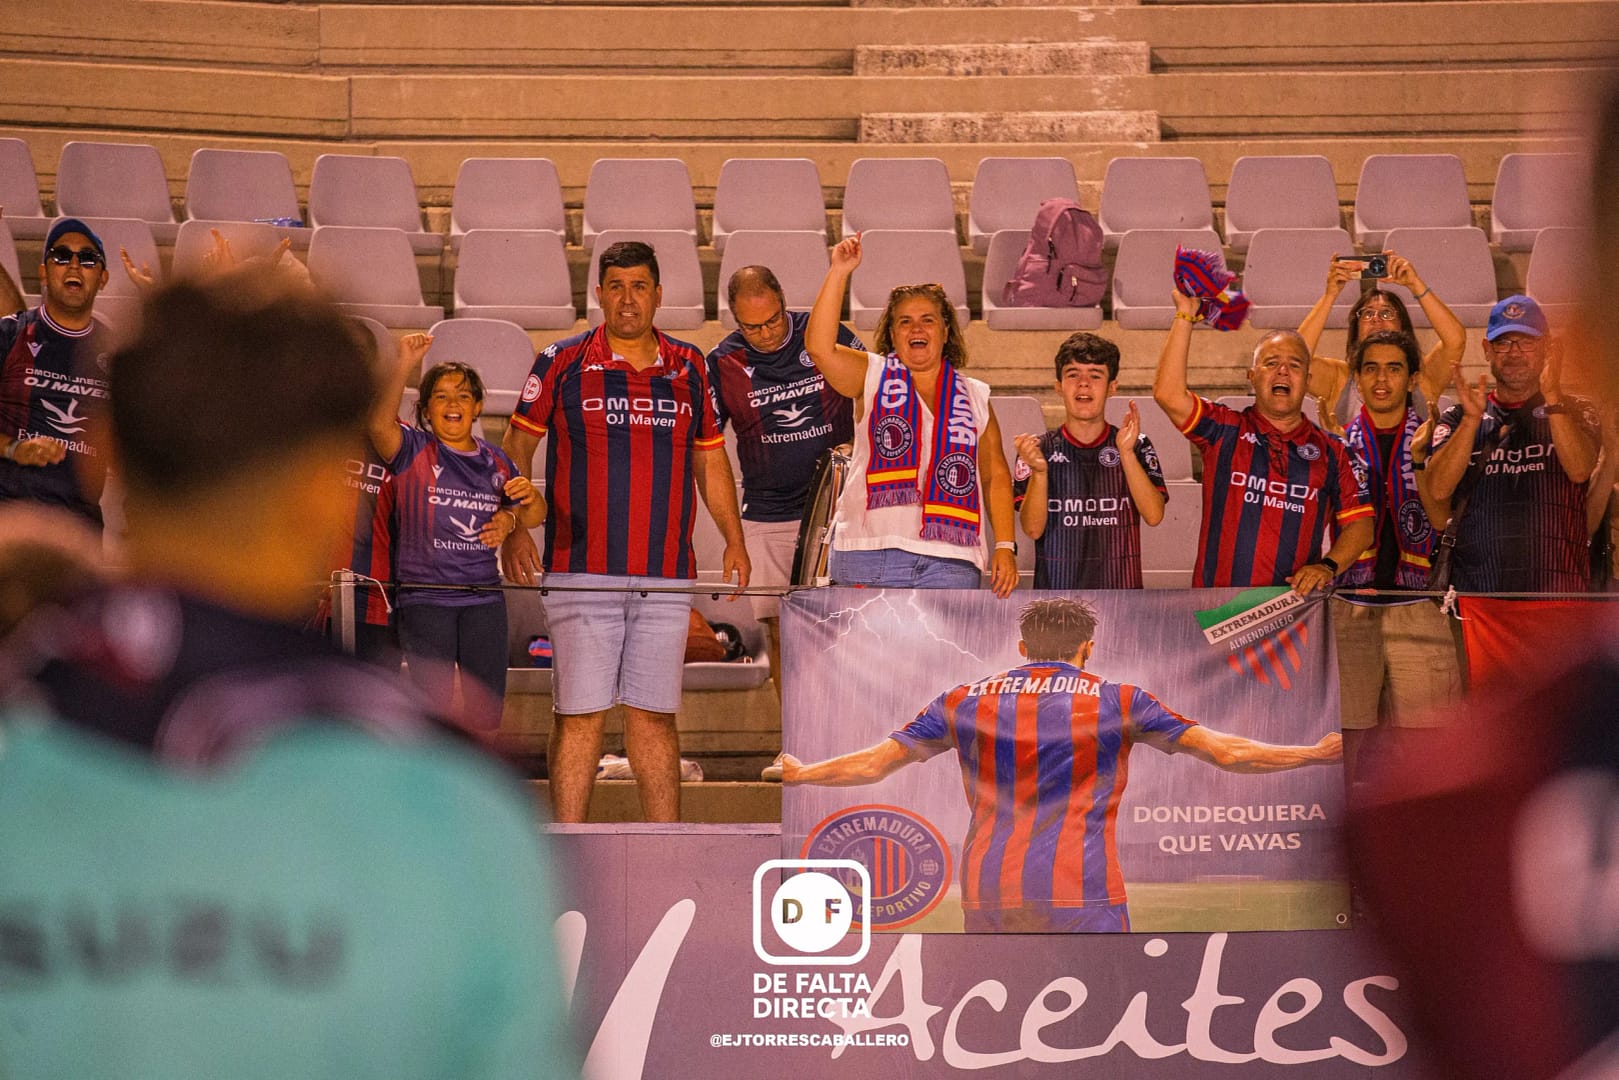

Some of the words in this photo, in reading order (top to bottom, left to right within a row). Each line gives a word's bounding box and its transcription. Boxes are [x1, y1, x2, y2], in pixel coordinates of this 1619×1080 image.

[24, 376, 50, 388] OJ
[72, 376, 109, 388] JAECO
[750, 396, 769, 408] OJ
[772, 381, 825, 403] MAVEN
[606, 413, 624, 425] OJ
[629, 413, 676, 428] Maven
[761, 423, 833, 445] Extremadura
[1485, 463, 1499, 476] OJ
[1503, 462, 1545, 475] Maven
[428, 496, 451, 506] OJ
[1244, 491, 1259, 504] OJ
[1263, 495, 1305, 514] Maven
[1063, 515, 1078, 527] OJ
[1210, 594, 1300, 639] EXTREMADURA
[1229, 614, 1294, 651] ALMENDRALEJO
[967, 676, 1101, 698] EXTREMADURA
[1134, 804, 1327, 825] DONDEQUIERA
[818, 816, 933, 855] EXTREMADURA
[1158, 835, 1212, 855] QUE
[1219, 832, 1301, 852] VAYAS
[826, 932, 1408, 1070] Aceites
